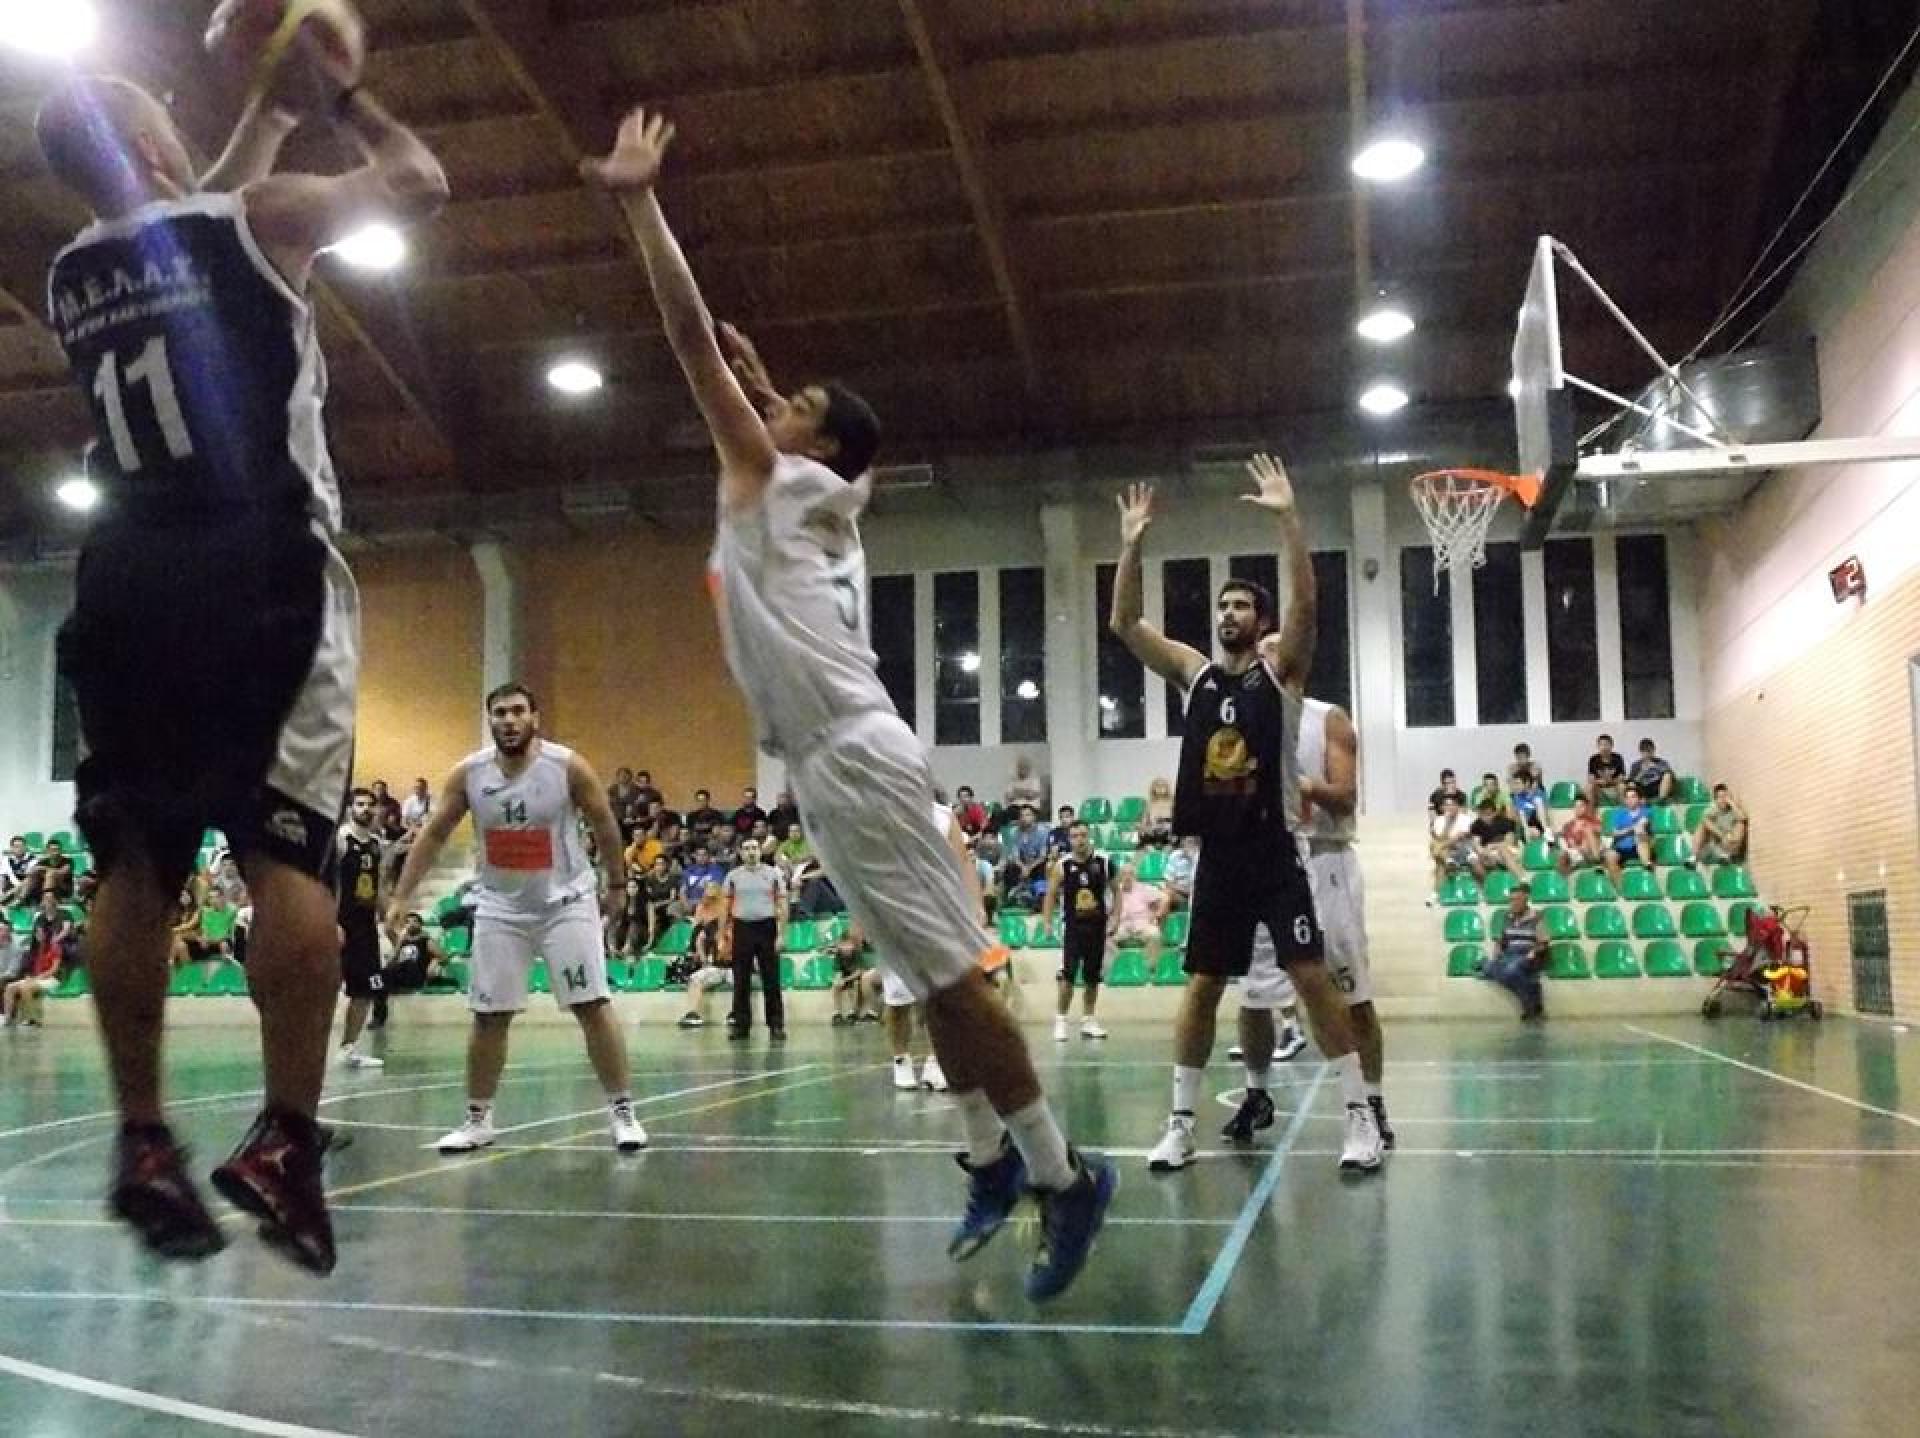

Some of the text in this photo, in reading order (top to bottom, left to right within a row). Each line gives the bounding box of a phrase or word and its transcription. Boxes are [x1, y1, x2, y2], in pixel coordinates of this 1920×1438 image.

[92, 335, 193, 473] 11
[1220, 697, 1237, 724] 6
[501, 800, 528, 824] 14
[1293, 914, 1312, 944] 6
[561, 963, 588, 991] 14
